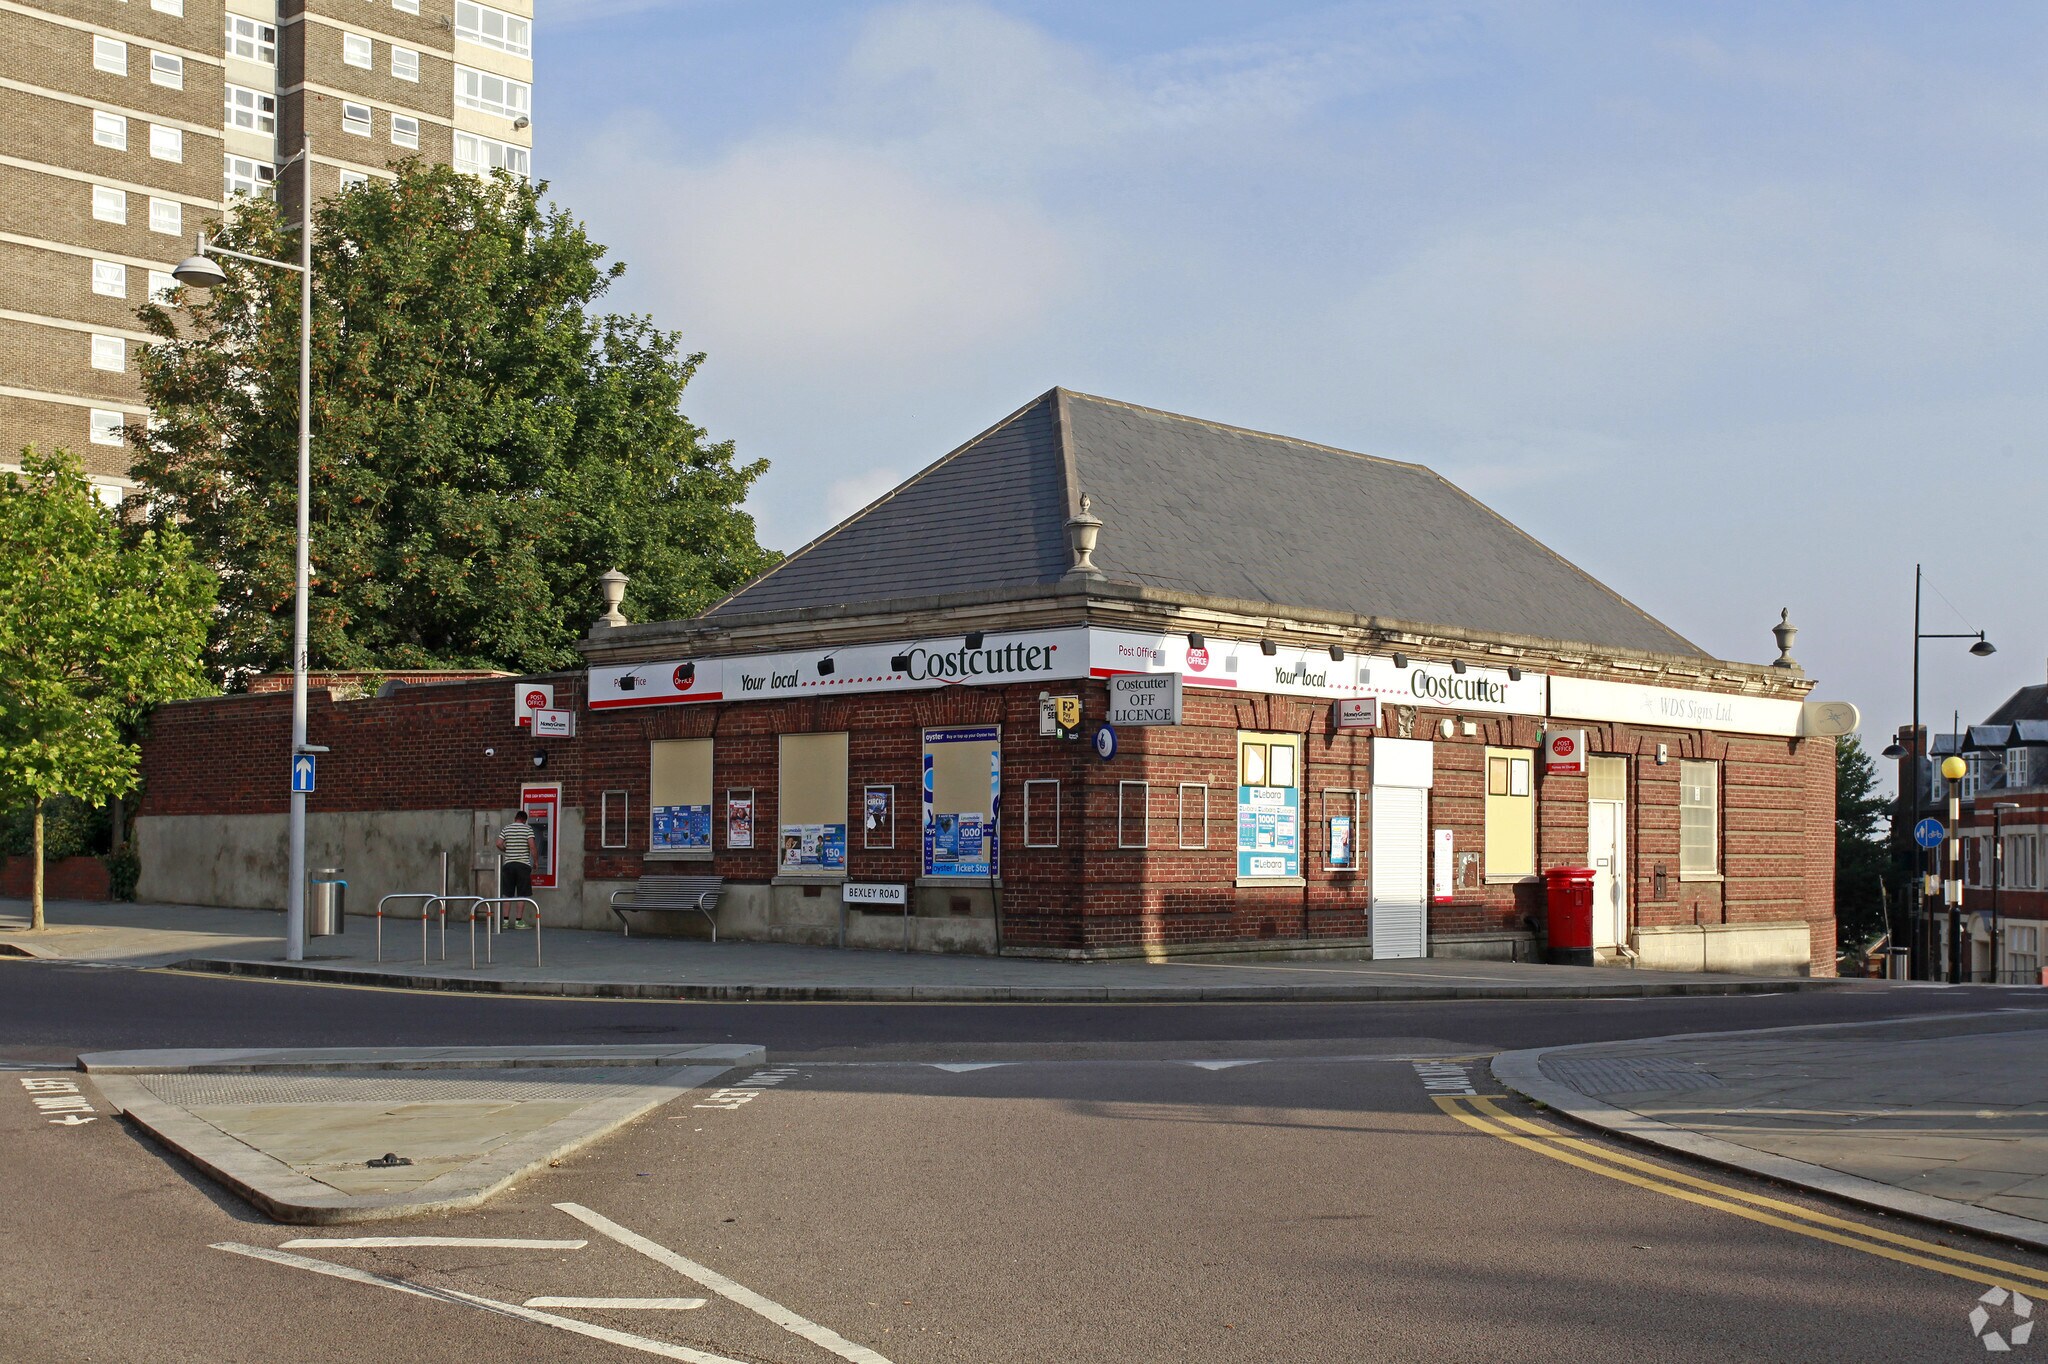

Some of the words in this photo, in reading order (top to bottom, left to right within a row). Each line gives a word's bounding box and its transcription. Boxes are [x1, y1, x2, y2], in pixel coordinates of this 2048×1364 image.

[1118, 644, 1135, 656] Post
[1136, 646, 1157, 659] Office
[907, 641, 1057, 681] Costcutter
[1187, 657, 1207, 666] OFFICE
[741, 674, 766, 691] Your
[770, 669, 798, 689] local
[1275, 667, 1298, 685] Your
[1302, 668, 1327, 688] local
[1116, 679, 1169, 692] Costcutter
[1411, 669, 1508, 704] Costcutter
[1130, 694, 1156, 706] OFF
[1115, 708, 1171, 721] LICENCE
[1660, 697, 1685, 718] WDS
[1687, 700, 1713, 724] Signs
[925, 733, 944, 742] oyster
[1259, 790, 1281, 799] Lebara
[1258, 814, 1275, 824] 1000
[960, 828, 980, 837] 1000
[825, 848, 840, 857] 150
[933, 864, 953, 872] oyster
[954, 863, 975, 873] Ticket
[1259, 859, 1282, 869] Lebara
[849, 888, 877, 898] BEXLEY
[879, 889, 900, 899] ROAD
[20, 1077, 80, 1094] LEFT
